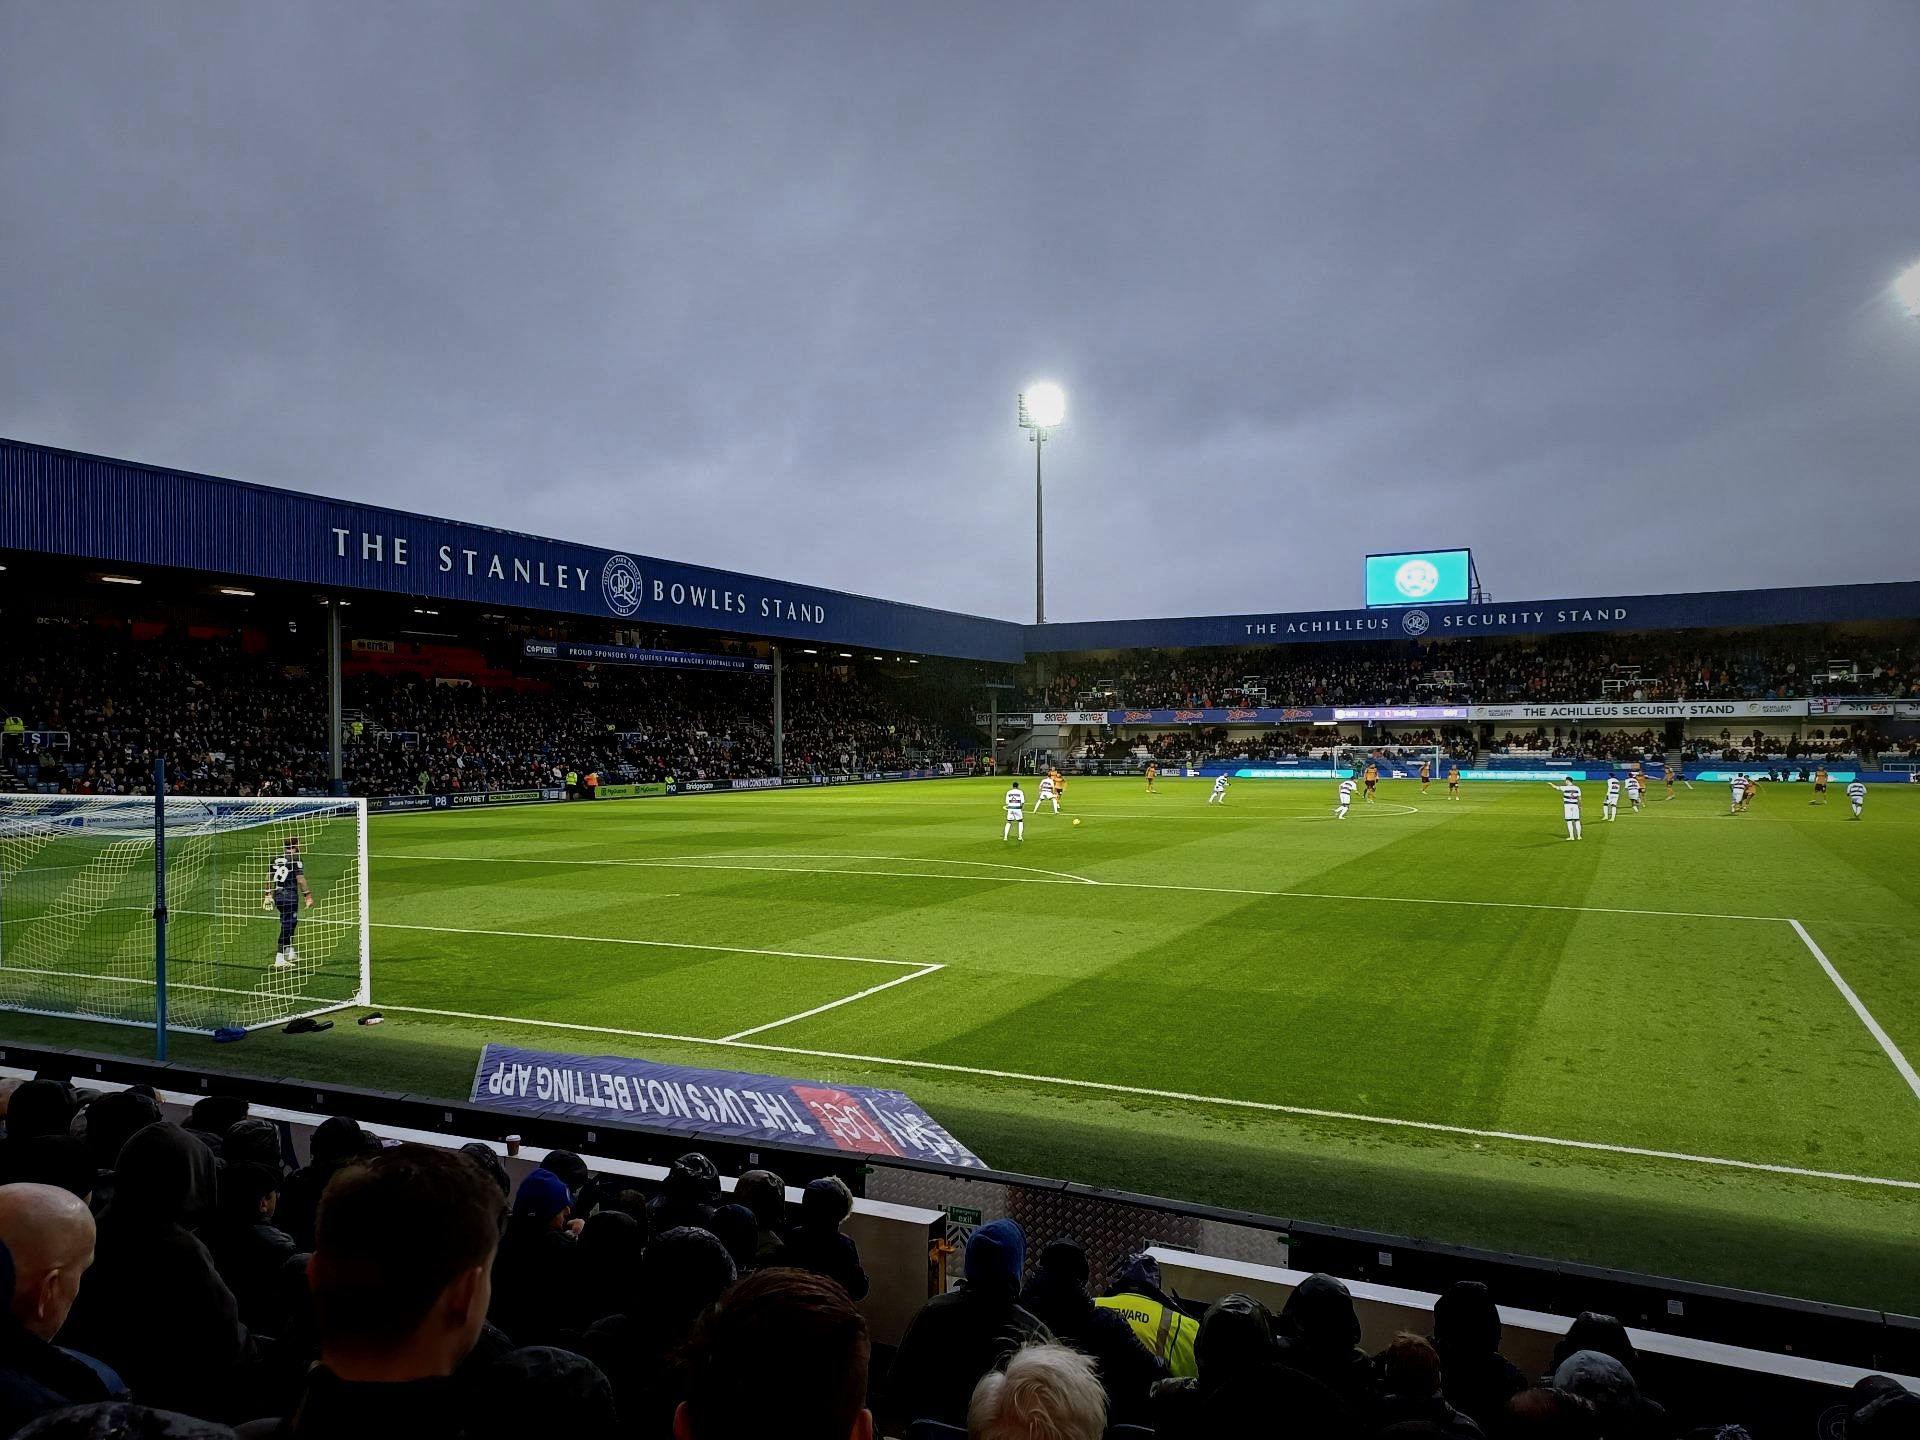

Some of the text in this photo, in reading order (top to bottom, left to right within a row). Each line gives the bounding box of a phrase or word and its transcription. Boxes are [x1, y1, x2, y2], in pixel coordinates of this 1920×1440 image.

[332, 527, 825, 624] THE STANLEY BOWLES STAND
[1245, 623, 1277, 635] THE
[1287, 618, 1389, 633] ACHILLEUS
[1443, 611, 1544, 627] SECURITY
[1558, 608, 1627, 623] STAND
[569, 648, 593, 656] PROUD
[594, 650, 627, 659] SPONSORS
[640, 654, 663, 662] QUEENS
[664, 655, 678, 663] PARK
[680, 657, 704, 665] RANGERS
[705, 659, 731, 667] FOOTBALL
[1523, 705, 1735, 717] THE ACHILLEUS SECURITY STAND
[435, 796, 447, 807] P8
[488, 1062, 816, 1135] THE UK'S NO.1 BETTING APP
[809, 1100, 902, 1157] bet
[958, 1216, 973, 1224] exit
